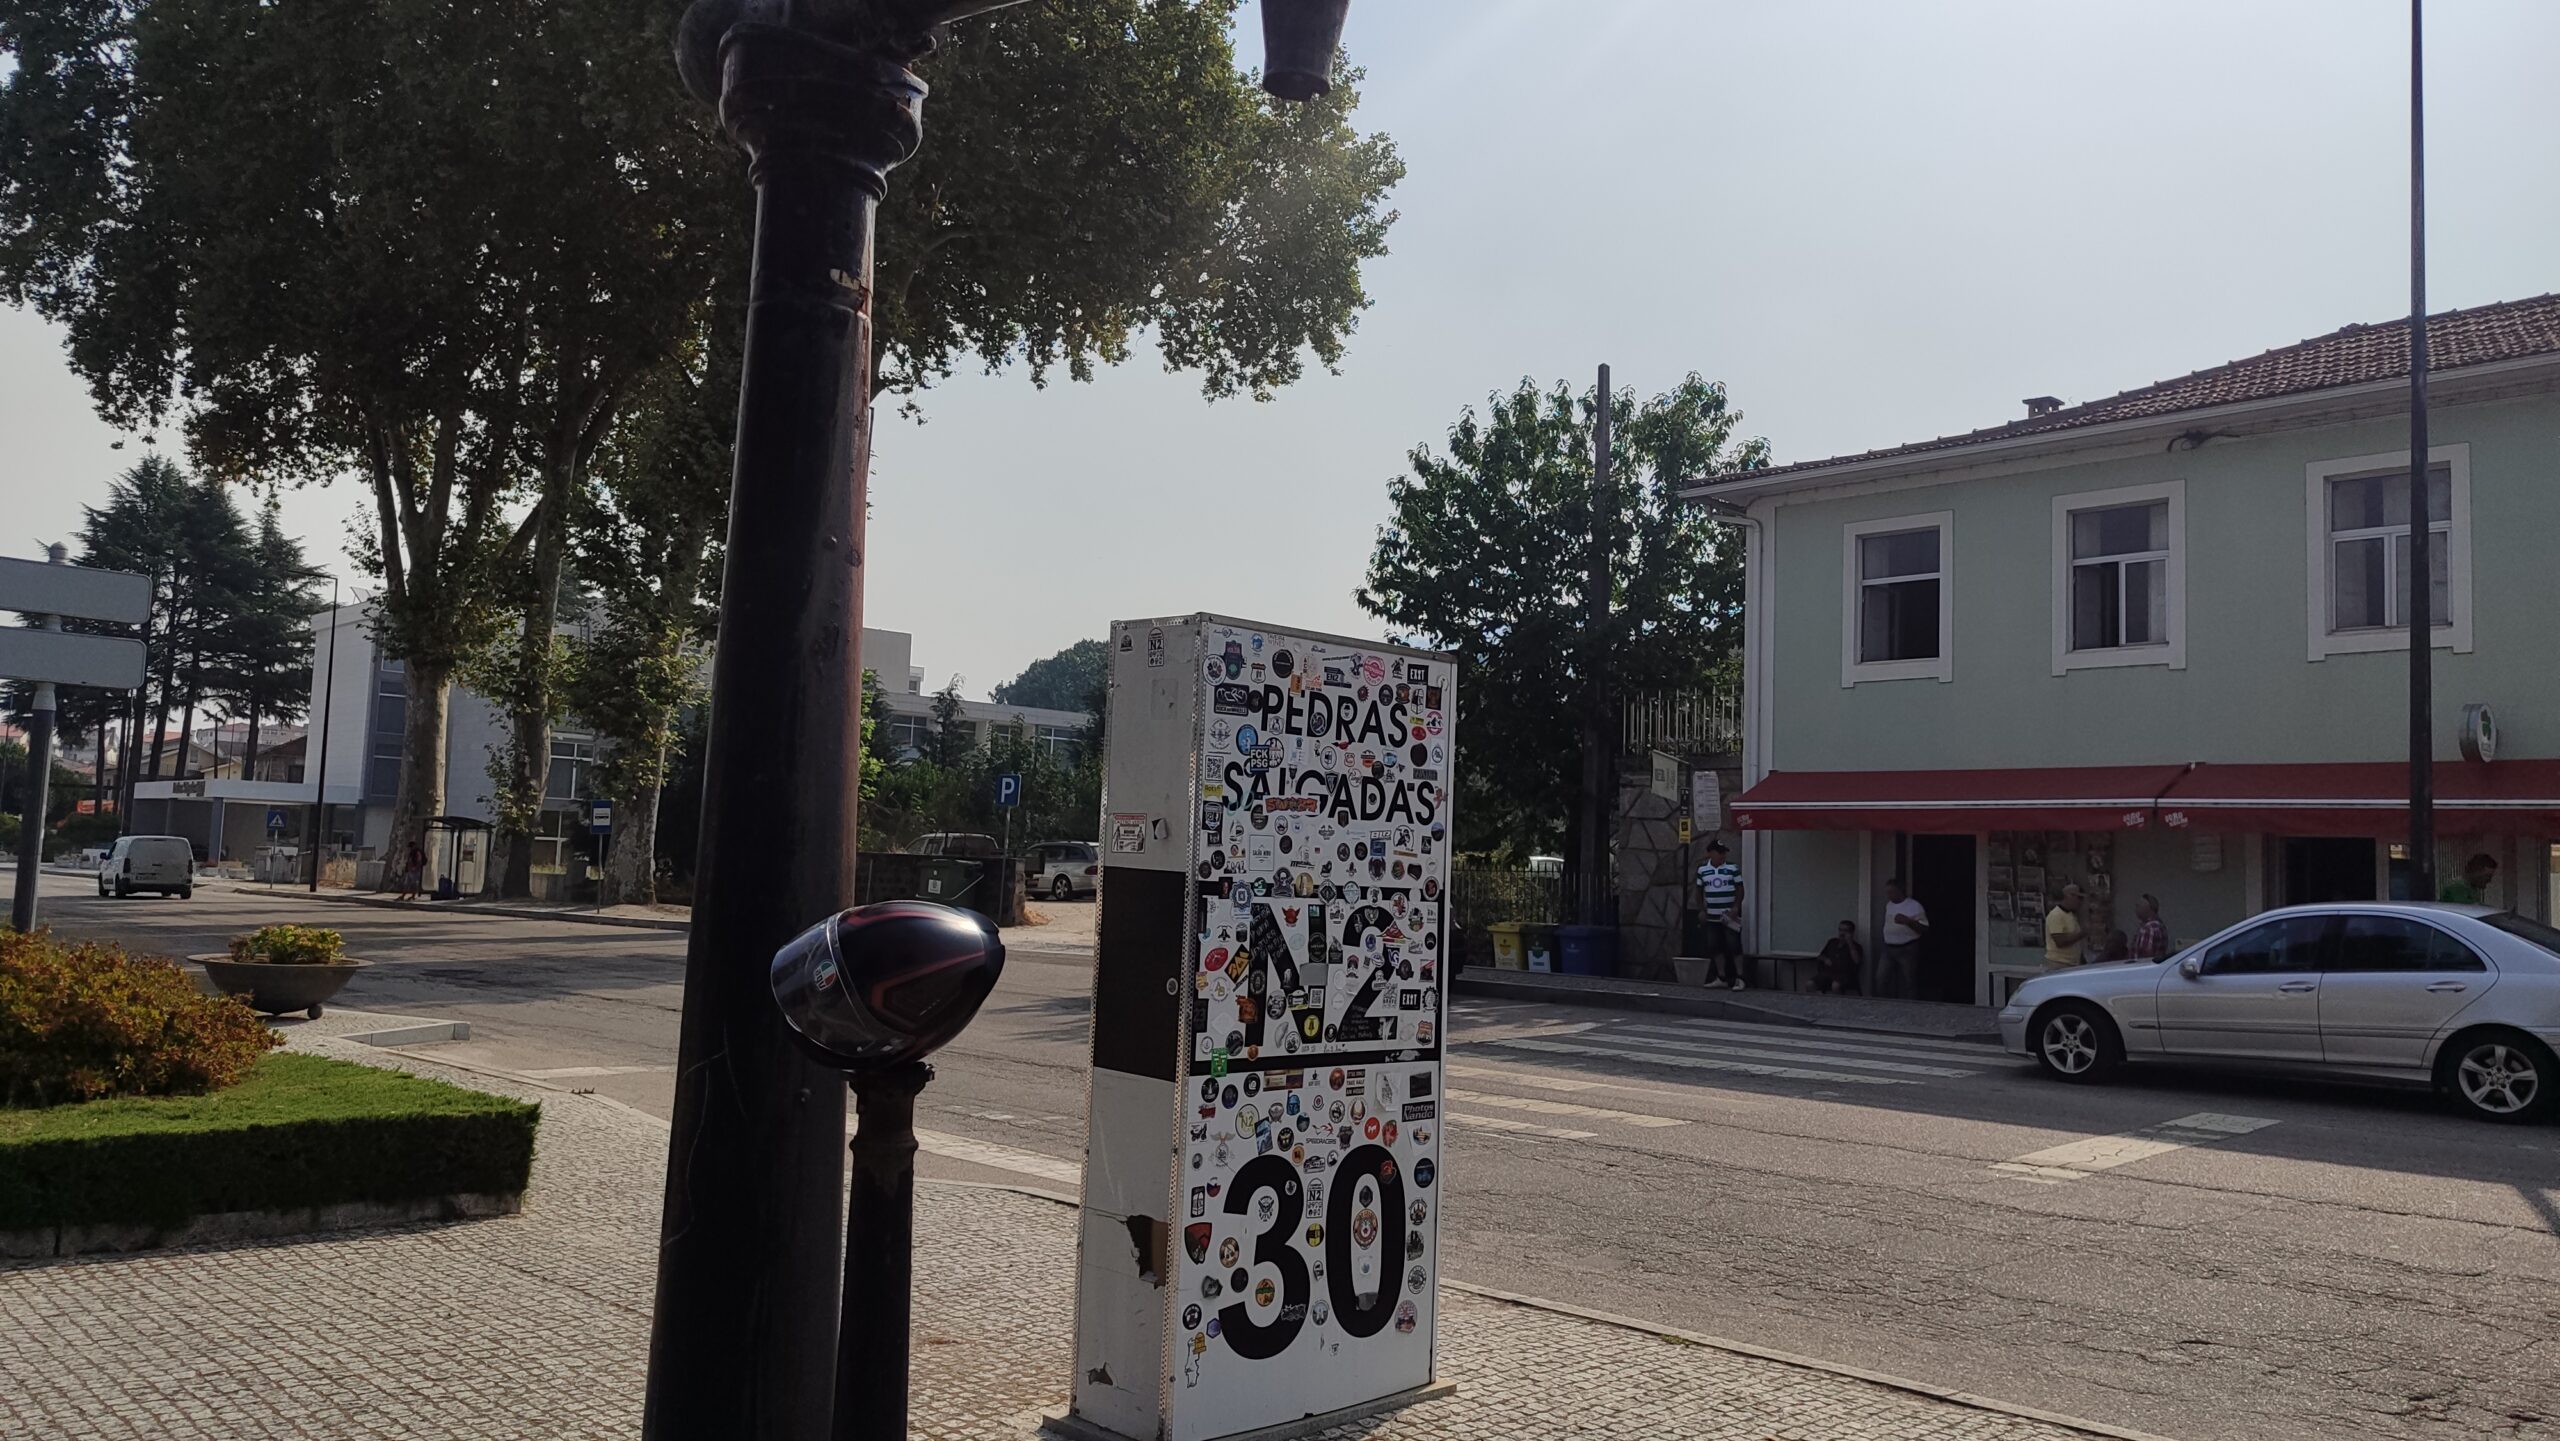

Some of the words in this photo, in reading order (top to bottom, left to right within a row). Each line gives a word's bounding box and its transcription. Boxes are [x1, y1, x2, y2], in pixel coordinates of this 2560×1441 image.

[1150, 639, 1162, 650] N2
[1261, 684, 1408, 748] PEDRAS
[1250, 748, 1268, 758] FCK
[1250, 758, 1268, 768] PSG
[1001, 777, 1015, 803] P
[1245, 902, 1398, 1047] N2
[1404, 1103, 1434, 1113] Photos
[1403, 1110, 1433, 1121] Nando
[1309, 1190, 1321, 1201] N2
[1218, 1144, 1406, 1360] 30
